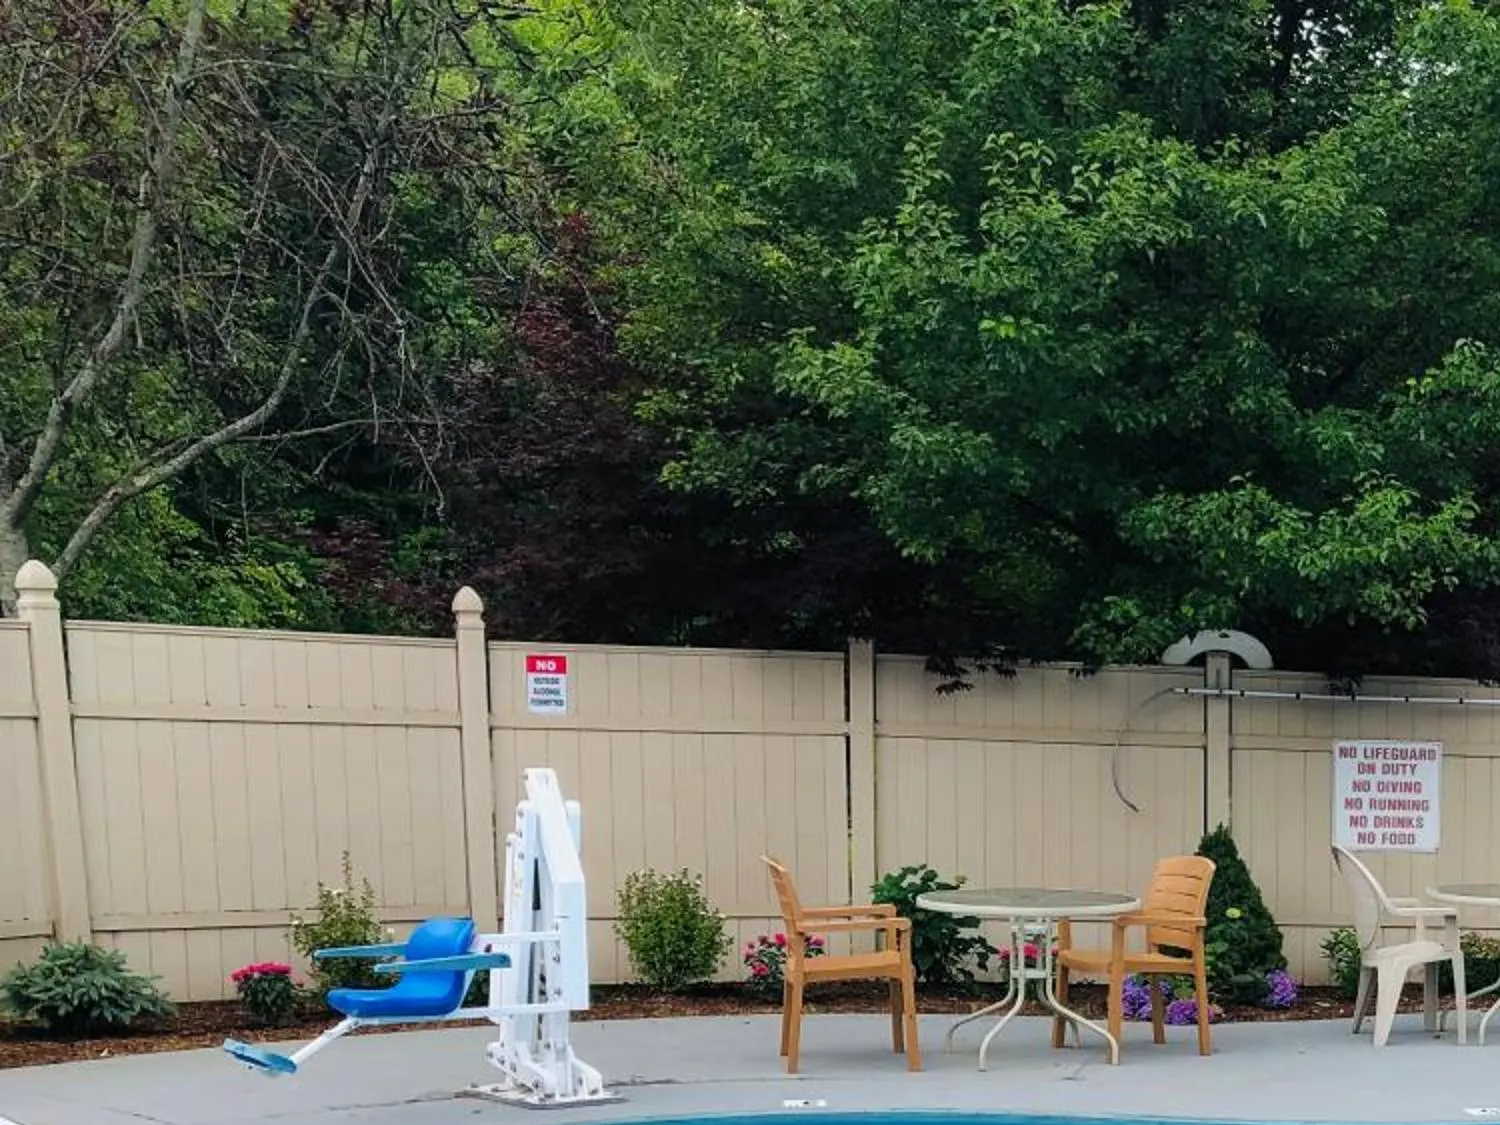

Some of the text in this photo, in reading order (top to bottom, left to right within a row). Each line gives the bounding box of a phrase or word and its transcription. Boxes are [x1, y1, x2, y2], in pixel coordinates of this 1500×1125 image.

[536, 660, 557, 671] NO
[1338, 746, 1437, 761] NO LIFEGUARD
[1357, 762, 1417, 775] ON DUTY
[1352, 780, 1422, 793] NO DIVING
[1344, 797, 1430, 812] NO RUNNING
[1349, 815, 1424, 829] NO DRINKS
[1357, 832, 1417, 845] NO FOOD
